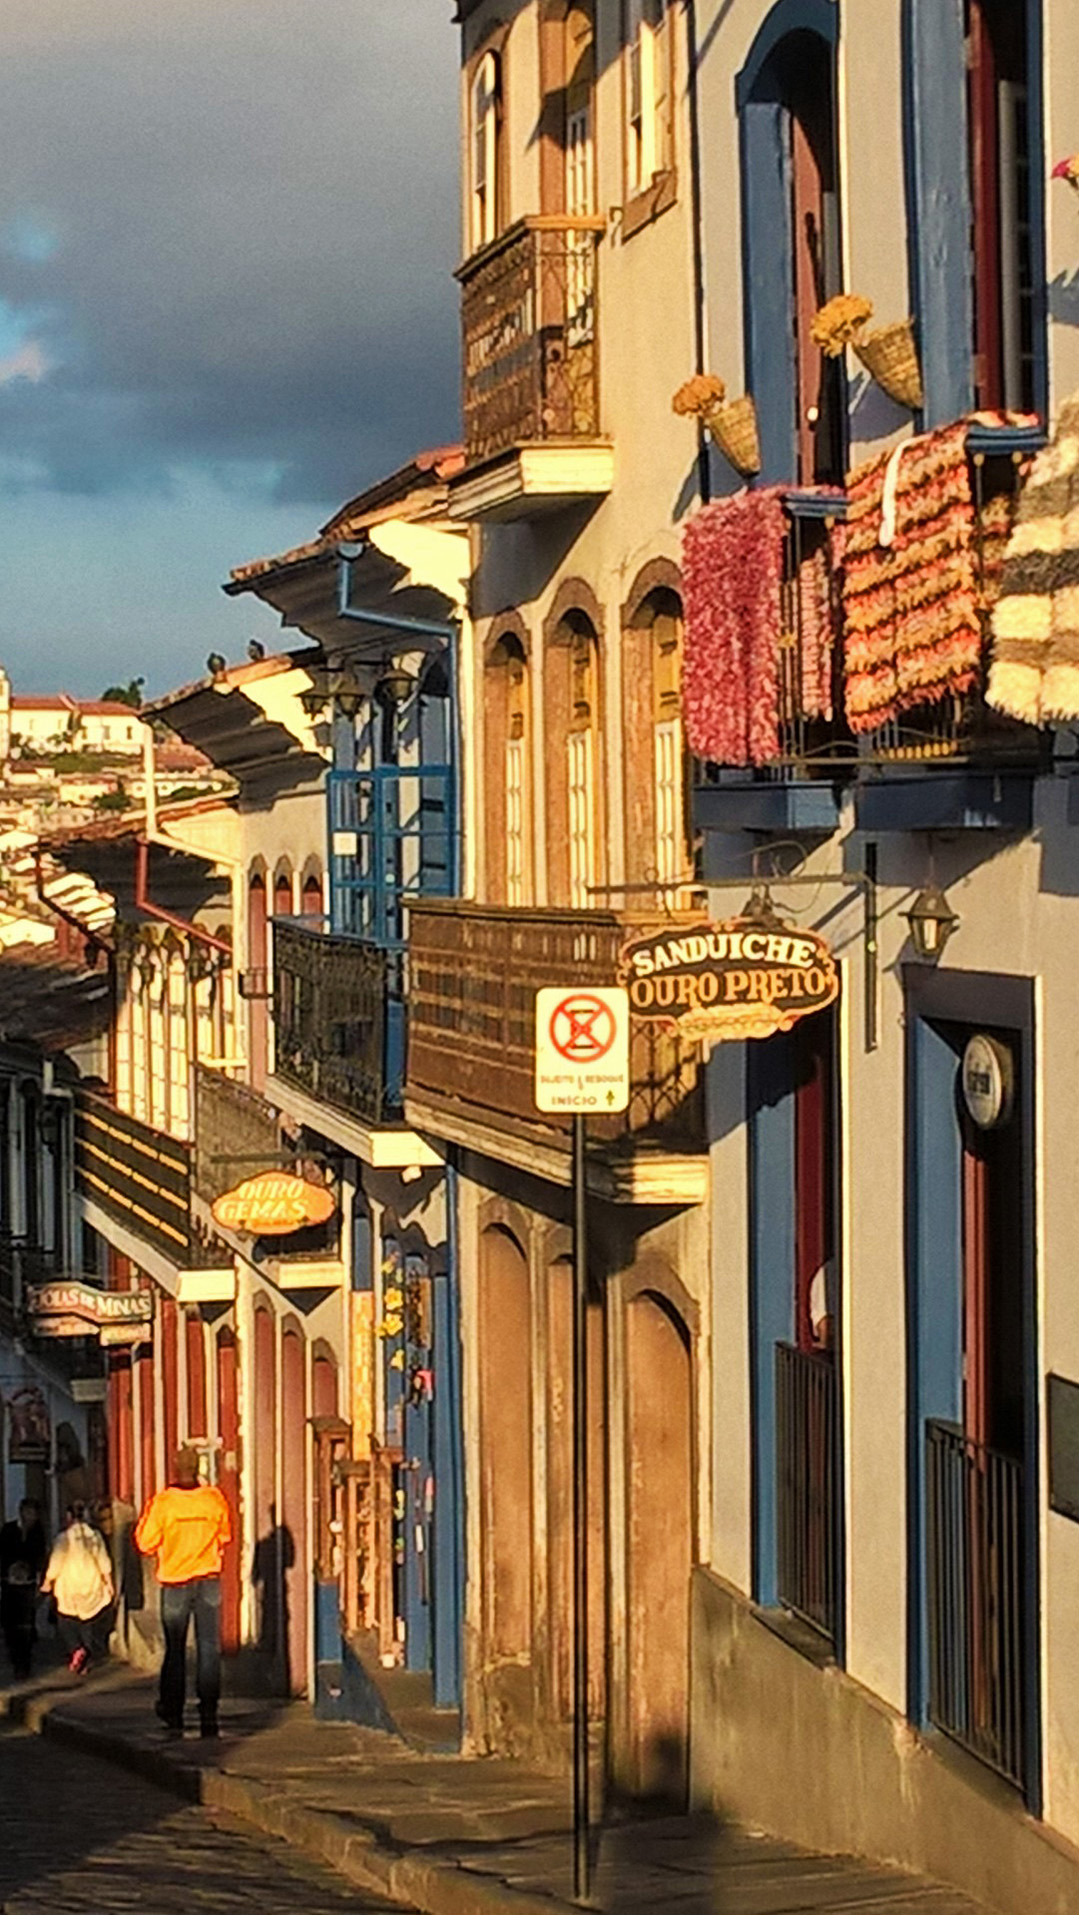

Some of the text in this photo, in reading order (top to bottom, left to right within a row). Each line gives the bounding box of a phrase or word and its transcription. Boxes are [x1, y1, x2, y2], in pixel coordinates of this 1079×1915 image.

[632, 933, 817, 977] SANDUICHE
[631, 967, 826, 1008] OURO PRETO
[240, 1181, 304, 1200] OURO
[219, 1200, 309, 1220] GEMAS
[96, 1296, 151, 1317] MINAS
